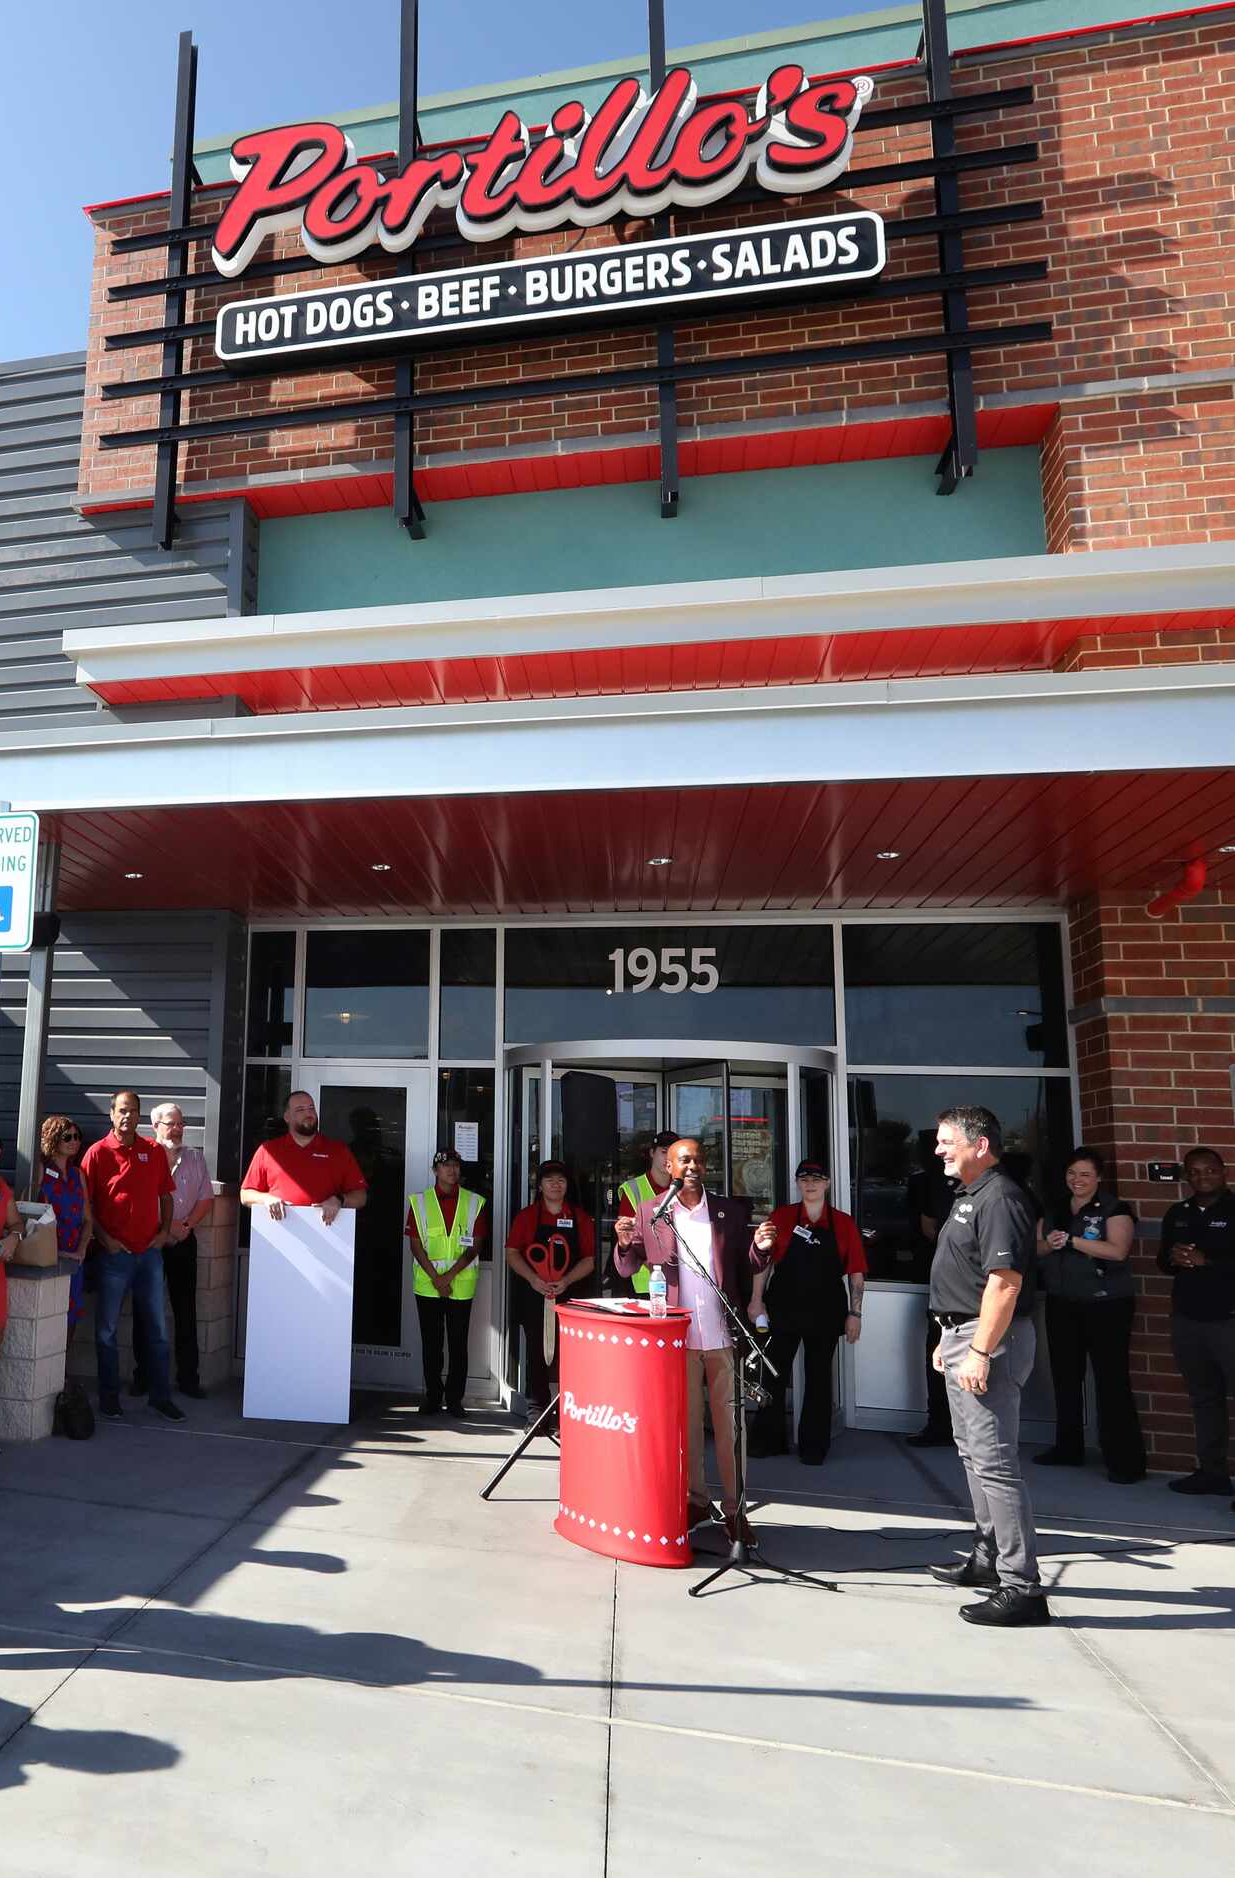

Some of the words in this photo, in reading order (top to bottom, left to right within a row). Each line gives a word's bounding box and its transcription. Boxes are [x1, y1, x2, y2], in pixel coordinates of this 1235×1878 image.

[212, 65, 861, 272] Portillo's
[235, 305, 297, 345] HOT
[306, 290, 393, 335] DOGS
[417, 276, 500, 320] BEEF
[525, 249, 692, 306] BURGERS
[711, 226, 859, 281] SALADS
[608, 947, 719, 993] 1955
[563, 1390, 636, 1434] Portillo's
